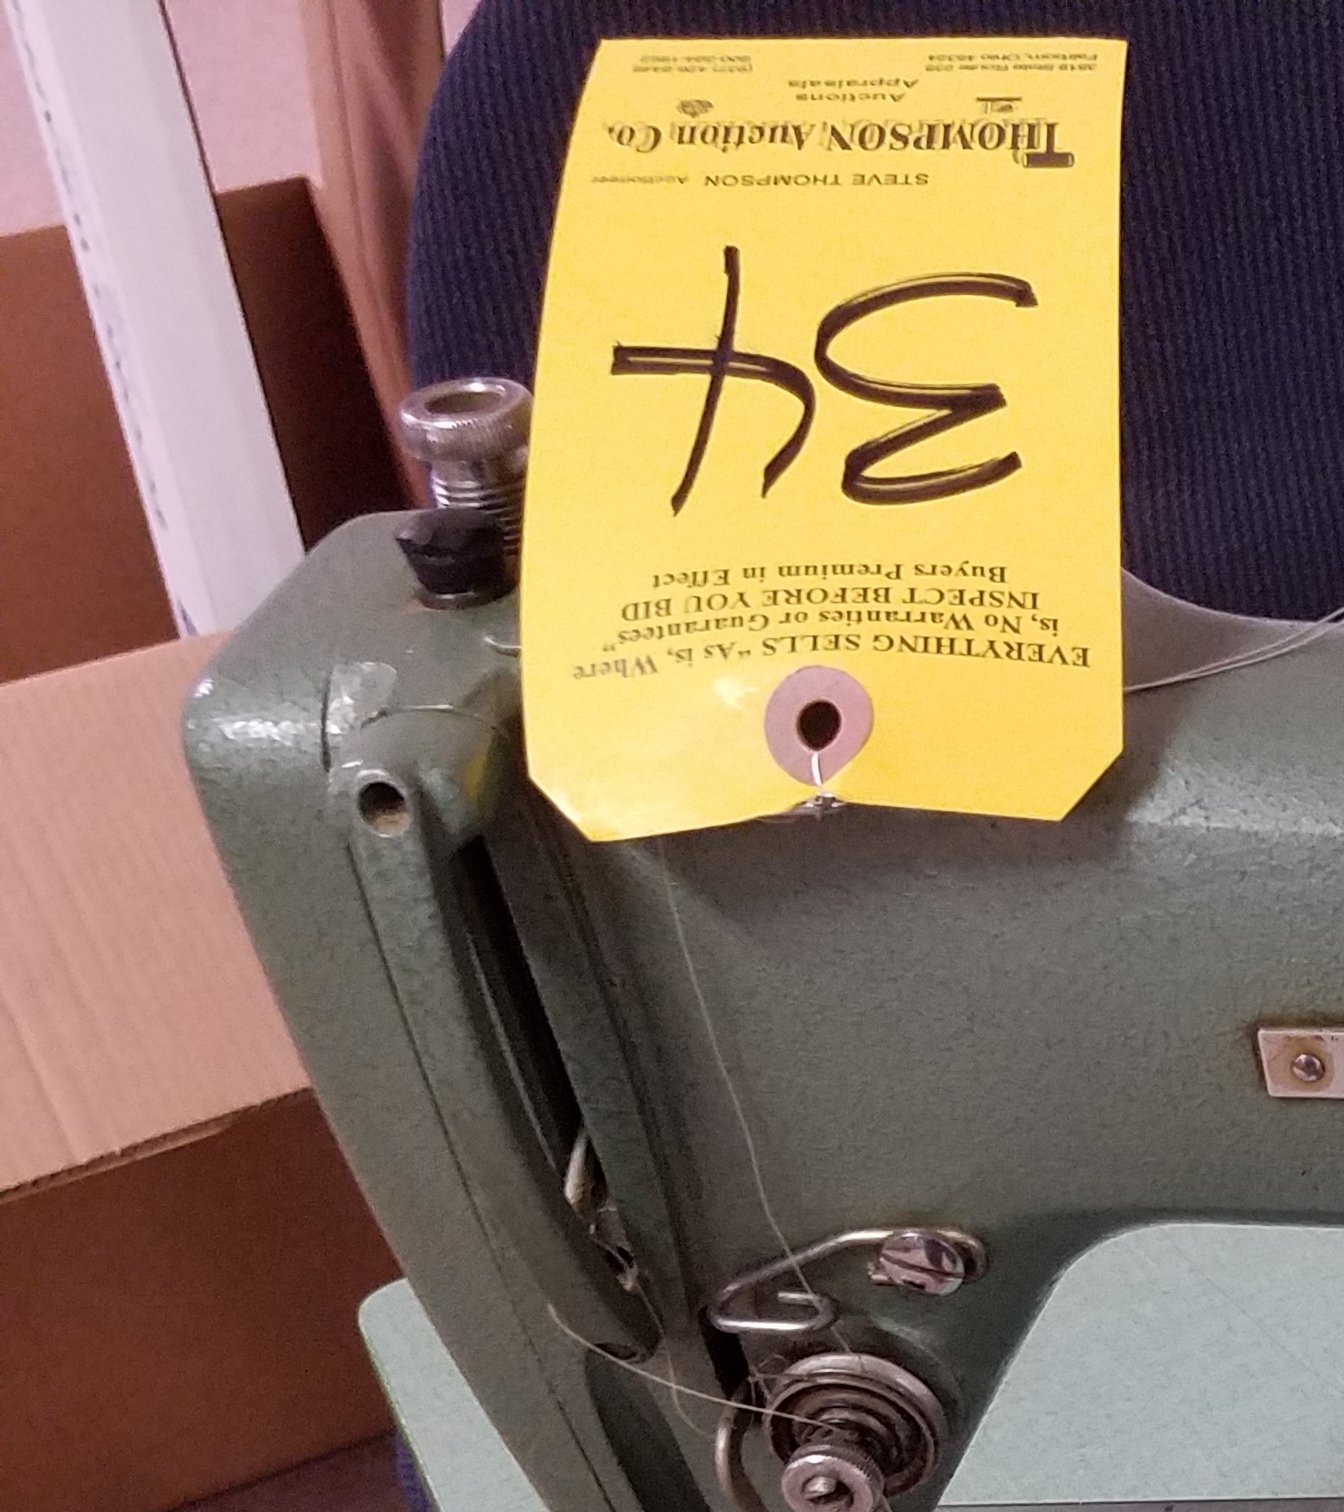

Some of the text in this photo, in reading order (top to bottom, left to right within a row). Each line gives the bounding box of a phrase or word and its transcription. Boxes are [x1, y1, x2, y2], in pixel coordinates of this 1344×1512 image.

[787, 78, 919, 89] Appraisals
[794, 92, 906, 103] Auctions
[605, 124, 662, 154] Co.
[673, 123, 816, 154] Auction
[704, 174, 841, 187] THOMPSON
[852, 173, 929, 186] STEVE
[611, 245, 1039, 518] 34
[652, 561, 1007, 590] Buyers Premium in Effect
[621, 587, 1039, 622] INSPECT BEFORE YOU BID
[779, 611, 808, 624] or
[819, 610, 975, 631] Warranties
[984, 614, 1022, 635] No
[1031, 614, 1058, 637] is,
[762, 634, 861, 656] SELLS
[872, 635, 1090, 668] EVERYTHING
[572, 654, 658, 680] Where
[667, 648, 693, 668] is,
